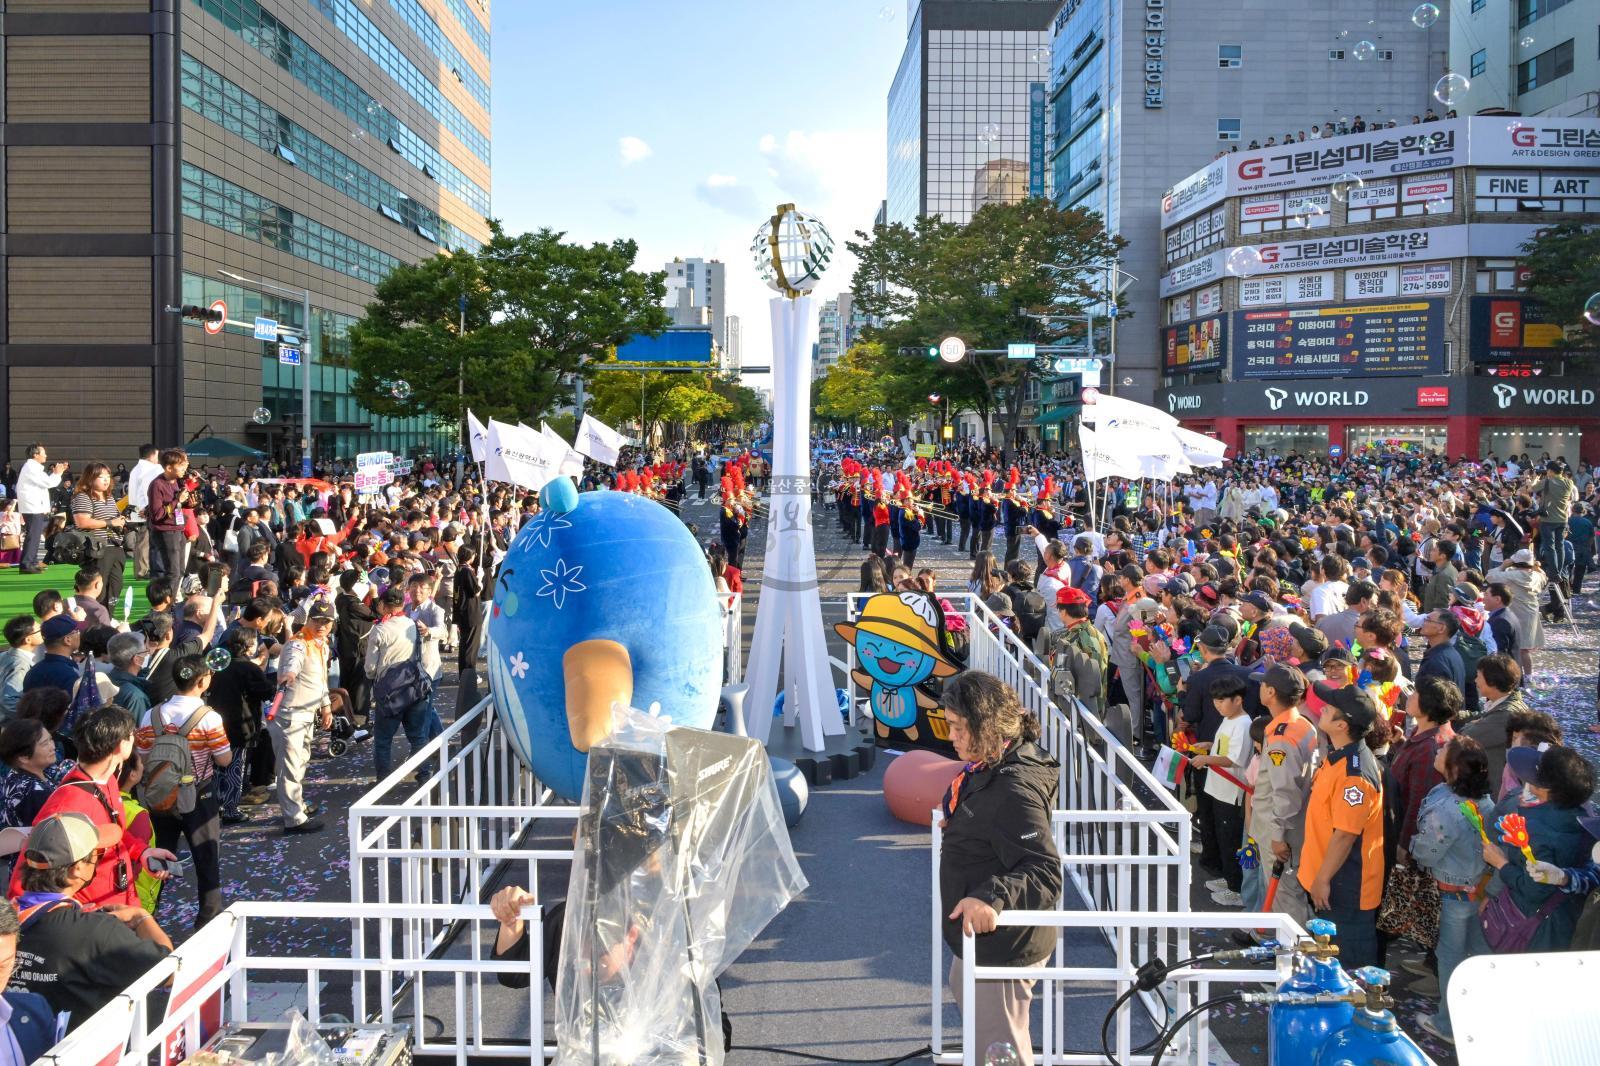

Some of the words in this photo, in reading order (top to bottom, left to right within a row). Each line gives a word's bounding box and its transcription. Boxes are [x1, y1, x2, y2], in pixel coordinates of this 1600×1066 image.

[1269, 130, 1454, 177] 그린섬미술학원
[1172, 166, 1223, 209] 그린섬미술학원
[1490, 178, 1528, 193] FINE
[1554, 179, 1590, 194] ART
[1283, 232, 1428, 262] 그린섬미술학원
[1269, 260, 1319, 270] ART&DESIGN
[1322, 256, 1366, 265] GREENSUM
[1354, 270, 1388, 280] 이화여대
[1247, 323, 1275, 333] 고려대
[1298, 320, 1336, 330] 이화여대
[946, 344, 958, 354] 50
[1247, 340, 1274, 350] 홍익대
[1298, 337, 1335, 347] 숙명여대
[1294, 354, 1340, 364] 서울시립대
[1177, 394, 1201, 409] WORLD
[1294, 390, 1369, 406] WORLD
[1522, 388, 1595, 405] WORLD
[698, 758, 730, 780] SHURE
[33, 972, 58, 982] ORANGE
